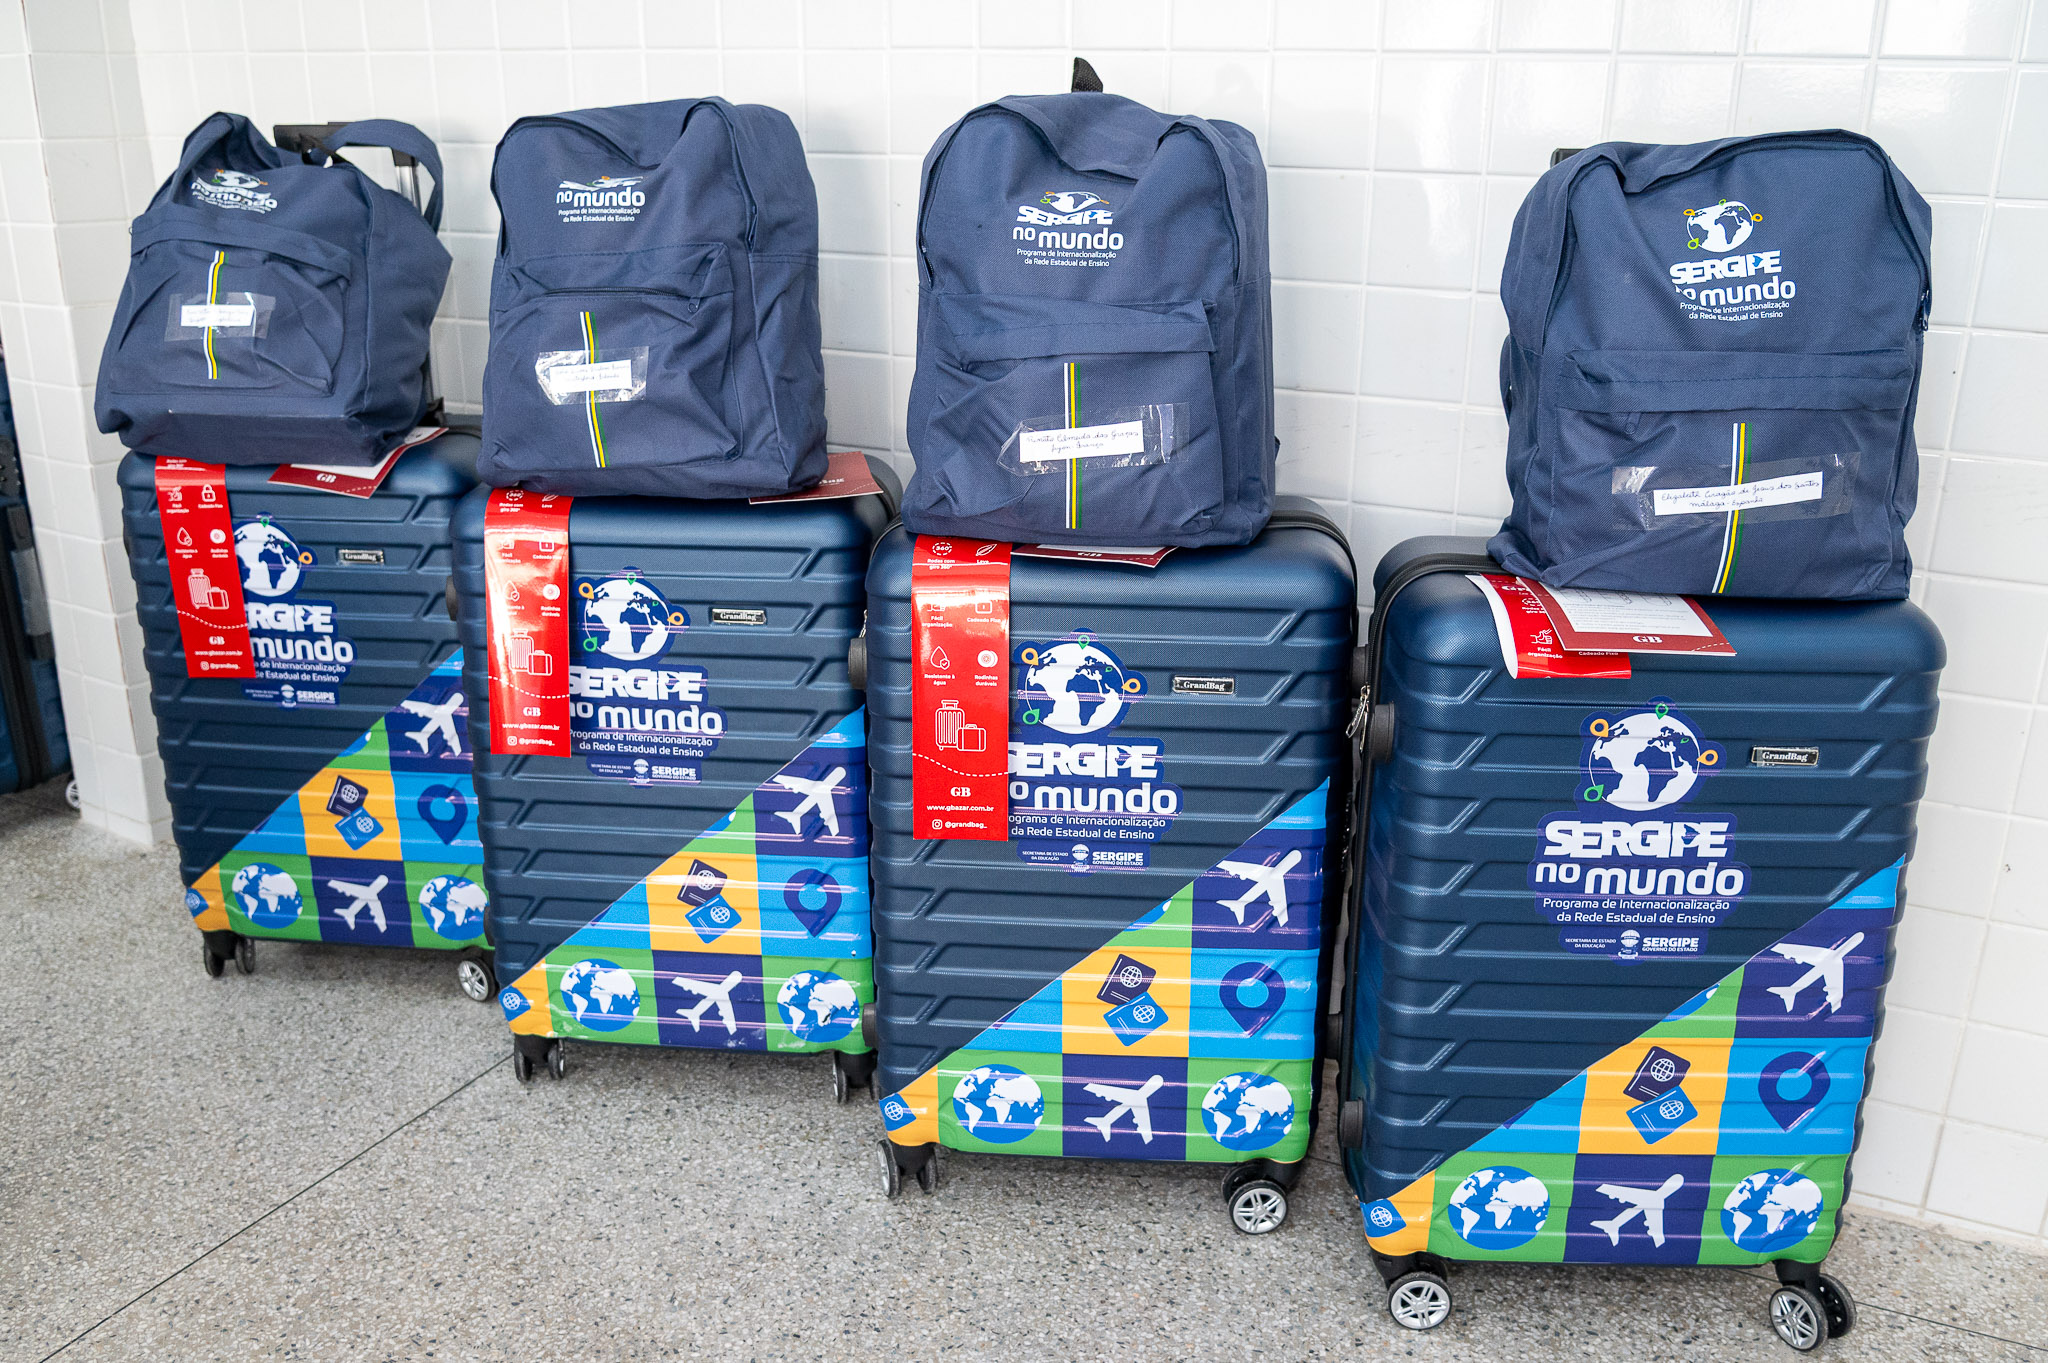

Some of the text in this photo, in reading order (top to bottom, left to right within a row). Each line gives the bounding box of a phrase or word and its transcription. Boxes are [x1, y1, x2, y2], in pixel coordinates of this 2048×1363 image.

[556, 187, 646, 207] no mundo
[1016, 205, 1114, 226] SERGIPE
[1013, 226, 1124, 250] no mundo
[1017, 248, 1046, 258] Programa
[1057, 250, 1117, 260] Internacionalização
[1034, 258, 1049, 266] Rede
[1079, 259, 1087, 267] de
[1669, 250, 1782, 285] SERGIPE
[1700, 275, 1796, 306] mundo
[1680, 301, 1790, 313] Programa de Internacionalização
[1700, 312, 1716, 320] Rede
[1718, 311, 1748, 321] Estadual
[1750, 310, 1759, 319] de
[1761, 310, 1783, 319] Ensino
[316, 473, 336, 483] GB
[245, 602, 333, 633] RGIPE
[1632, 635, 1663, 643] GB
[250, 635, 354, 663] mundo
[272, 661, 346, 673] Internacionalização
[265, 671, 299, 680] Estadual
[301, 673, 311, 681] de
[312, 673, 339, 682] Ensino
[1183, 681, 1225, 691] GrandBag
[296, 690, 335, 700] SERGIPE
[523, 706, 541, 717] GB
[598, 705, 723, 735] mundo
[613, 731, 624, 741] de
[626, 732, 712, 747] Internacionalização
[579, 741, 704, 757] da Rede Estadual de Ensino
[1762, 752, 1808, 762] GrandBag
[651, 765, 697, 777] SERGIPE
[950, 786, 971, 797] GB
[1034, 782, 1177, 814] mundo
[945, 821, 987, 829] @grandbag_
[1008, 815, 1165, 828] ograma de Internacionalização
[1011, 826, 1154, 840] da Rede Estadual de Ensino
[1544, 820, 1729, 859] SERGIPE
[1092, 851, 1143, 861] SERGIPE
[1535, 862, 1744, 896] no mundo
[1543, 899, 1730, 911] Programa de Internacionalização
[1557, 912, 1715, 924] da Rede Estadual de Ensino
[1642, 937, 1699, 948] SERGIPE
